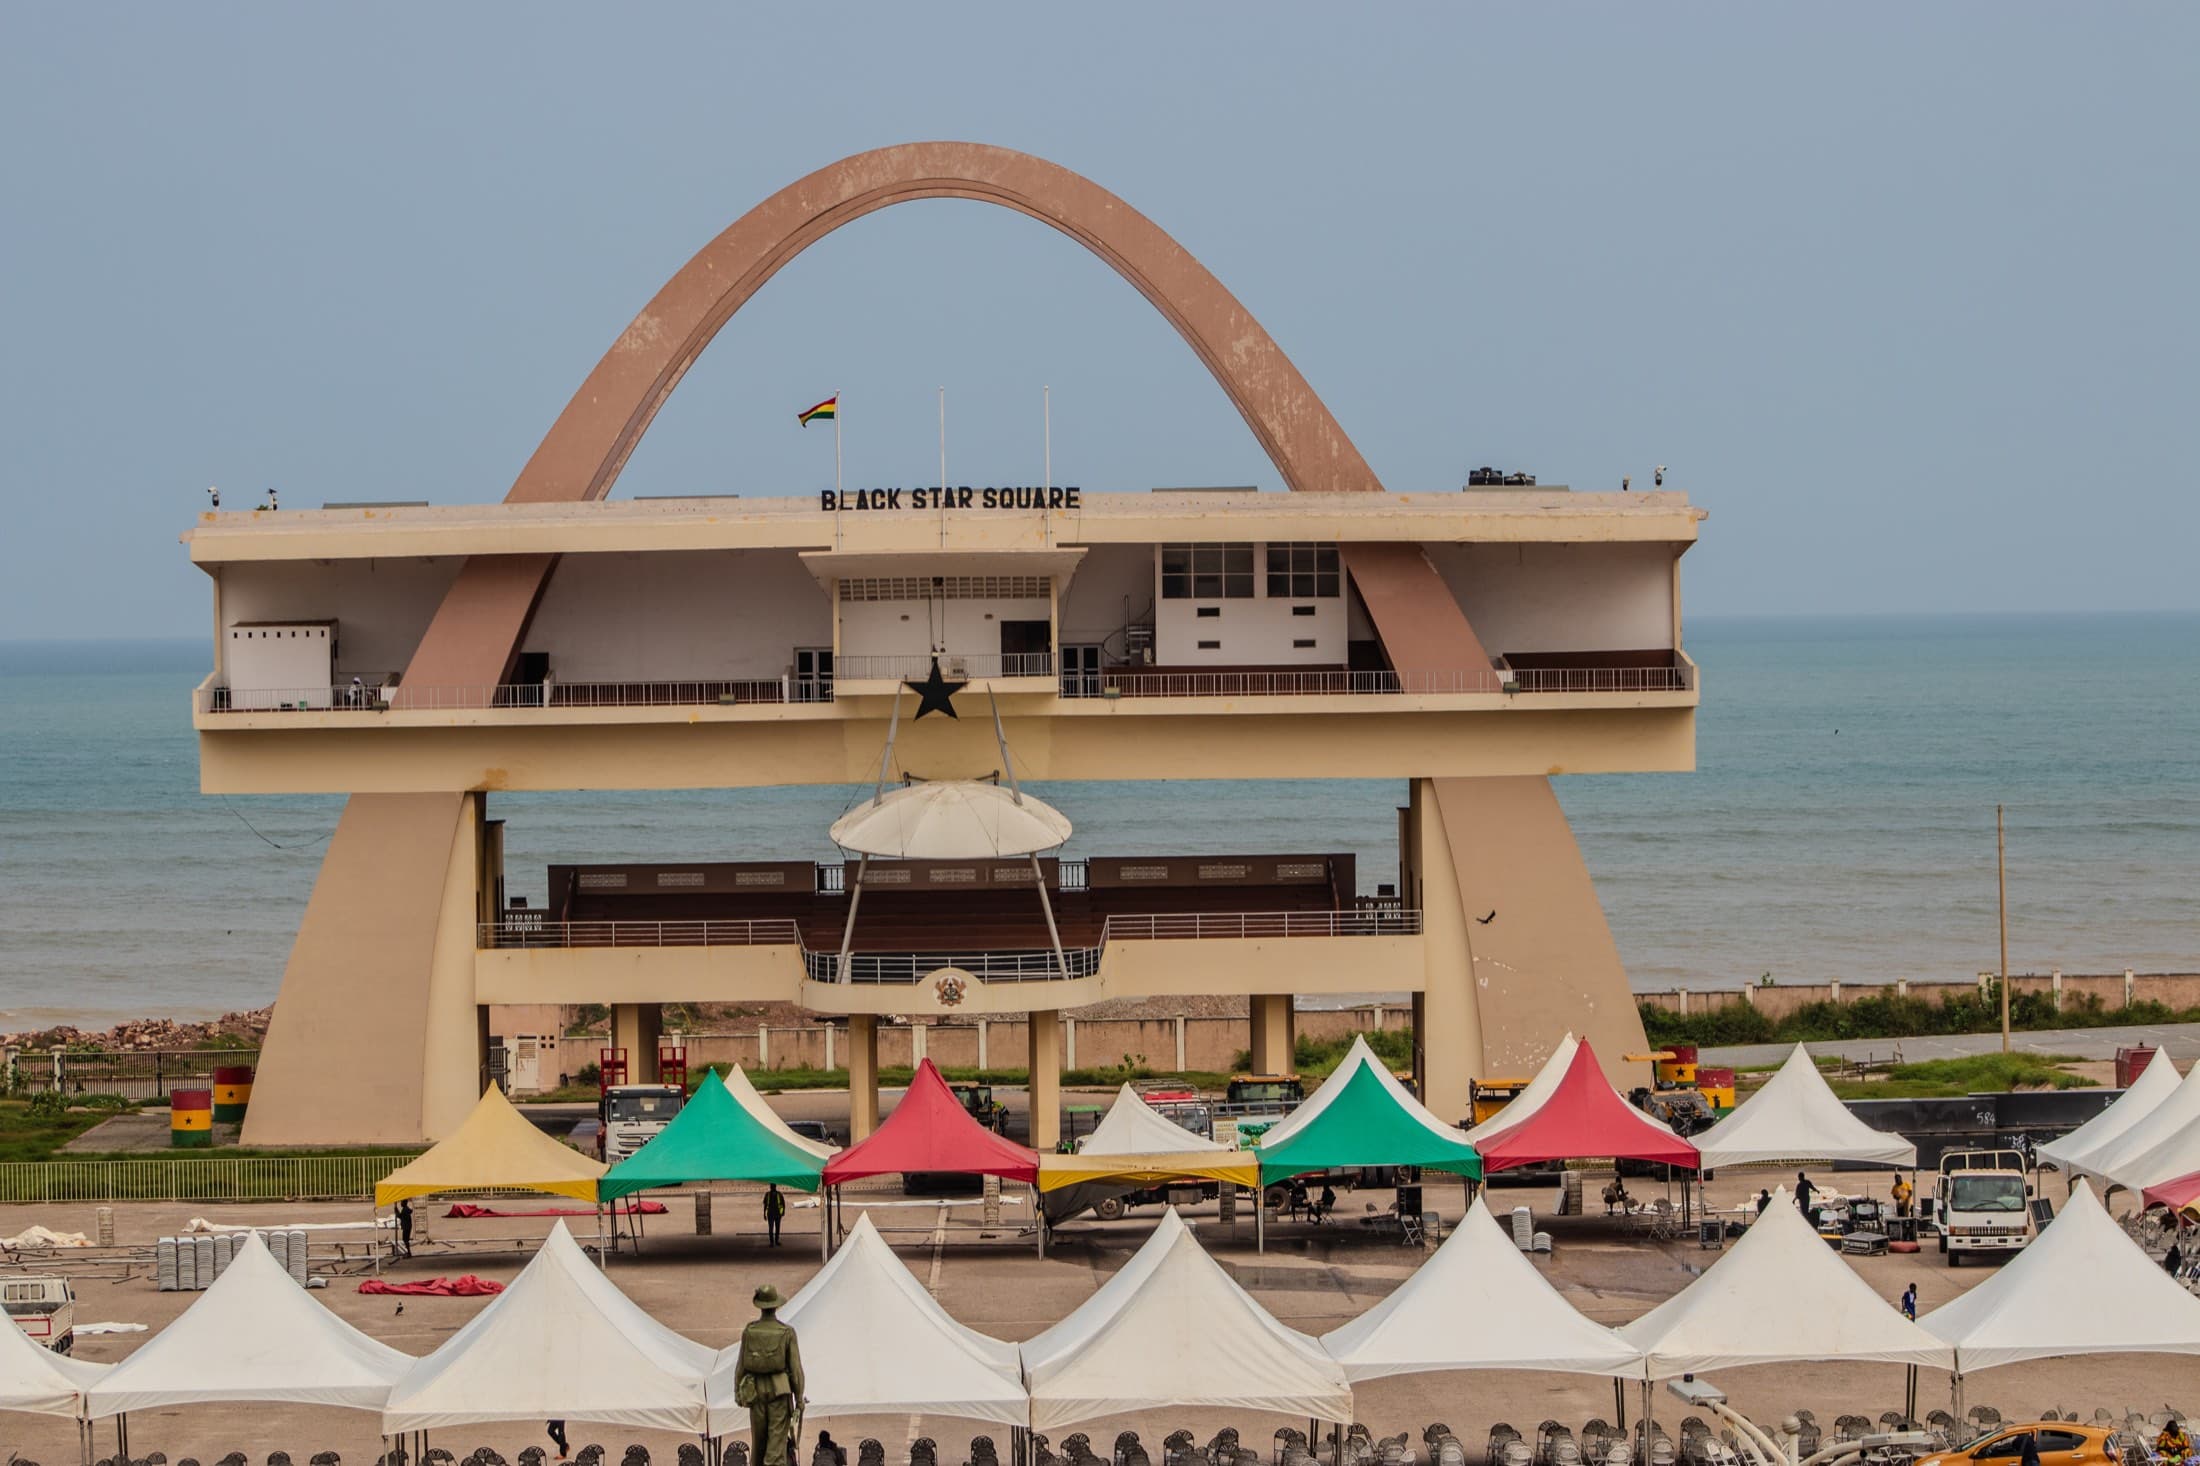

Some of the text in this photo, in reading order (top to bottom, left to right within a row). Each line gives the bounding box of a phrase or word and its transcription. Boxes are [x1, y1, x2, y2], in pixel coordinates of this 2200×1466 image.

[821, 487, 1081, 511] BLACK STAR SQUARE
[1976, 1111, 1996, 1126] 584
